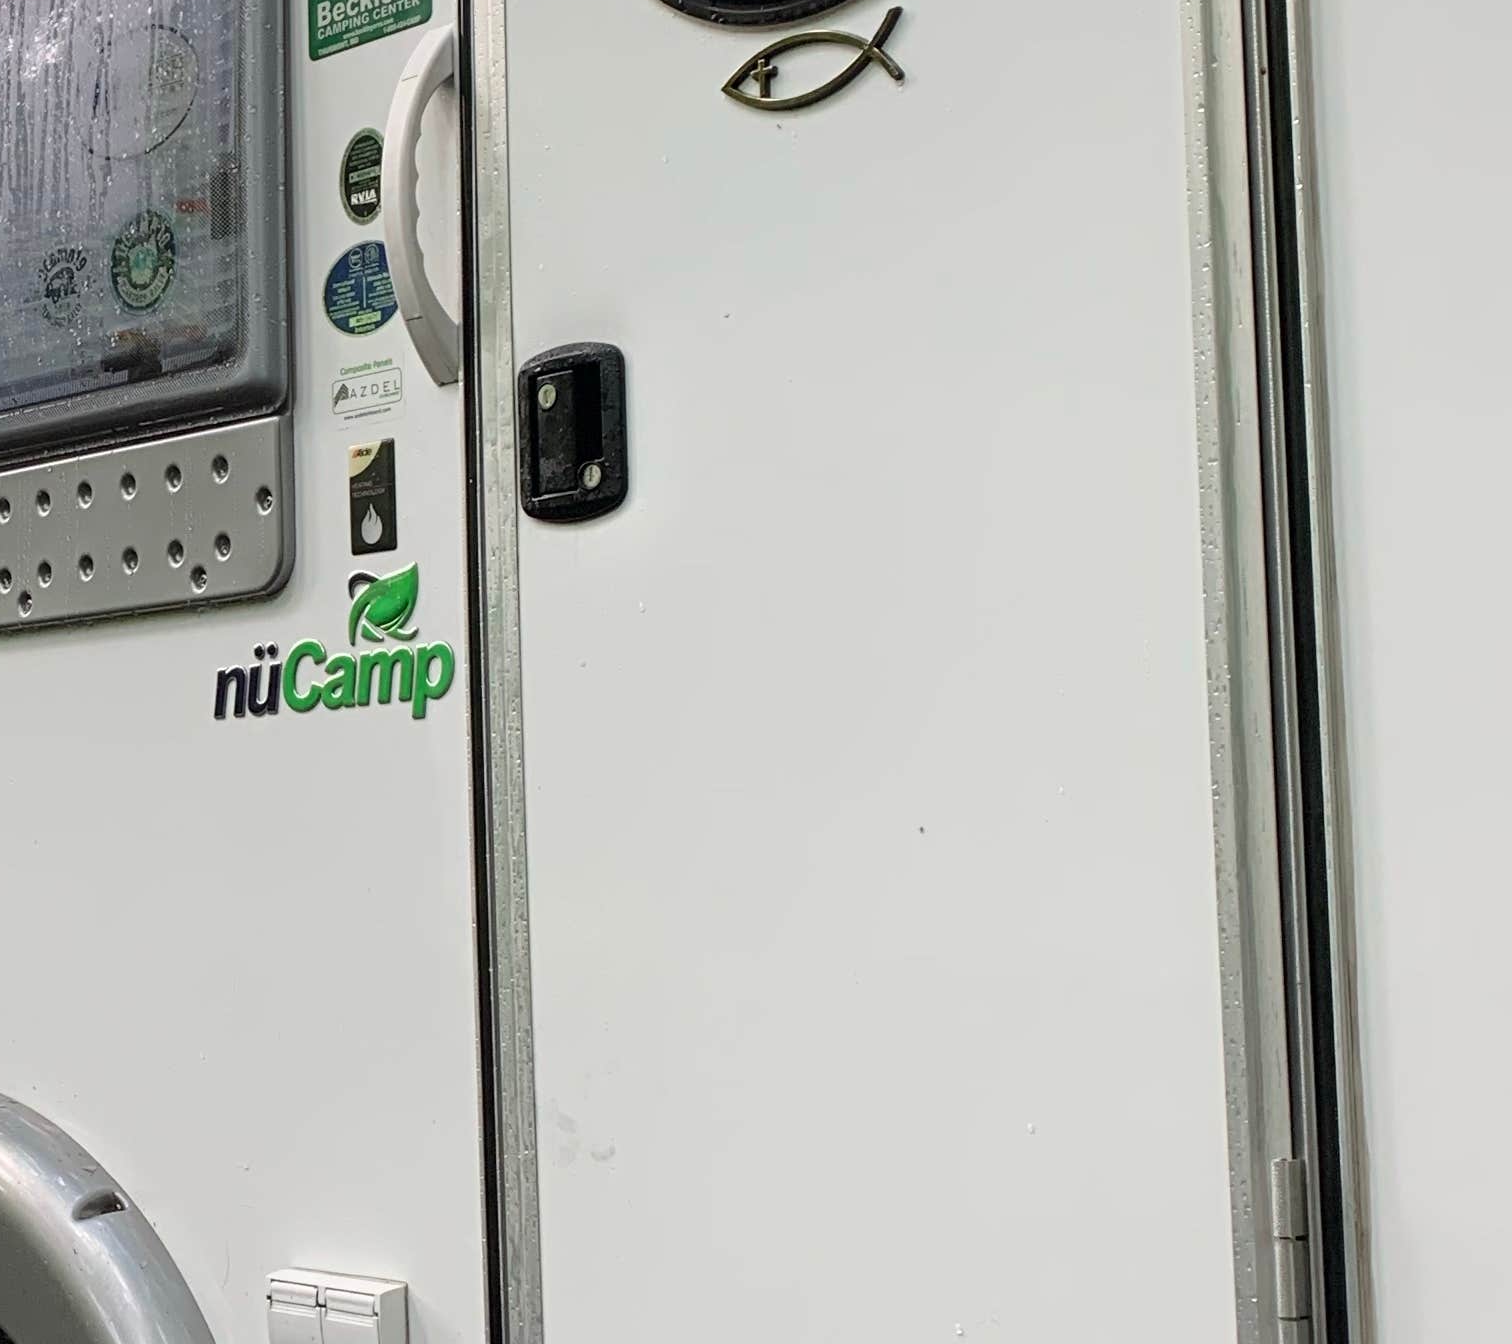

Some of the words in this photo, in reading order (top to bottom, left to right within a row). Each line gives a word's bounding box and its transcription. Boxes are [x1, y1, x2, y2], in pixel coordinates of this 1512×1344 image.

[317, 13, 370, 40] CAMPING
[350, 379, 400, 399] AZDEL
[214, 637, 456, 720] nüCamp
